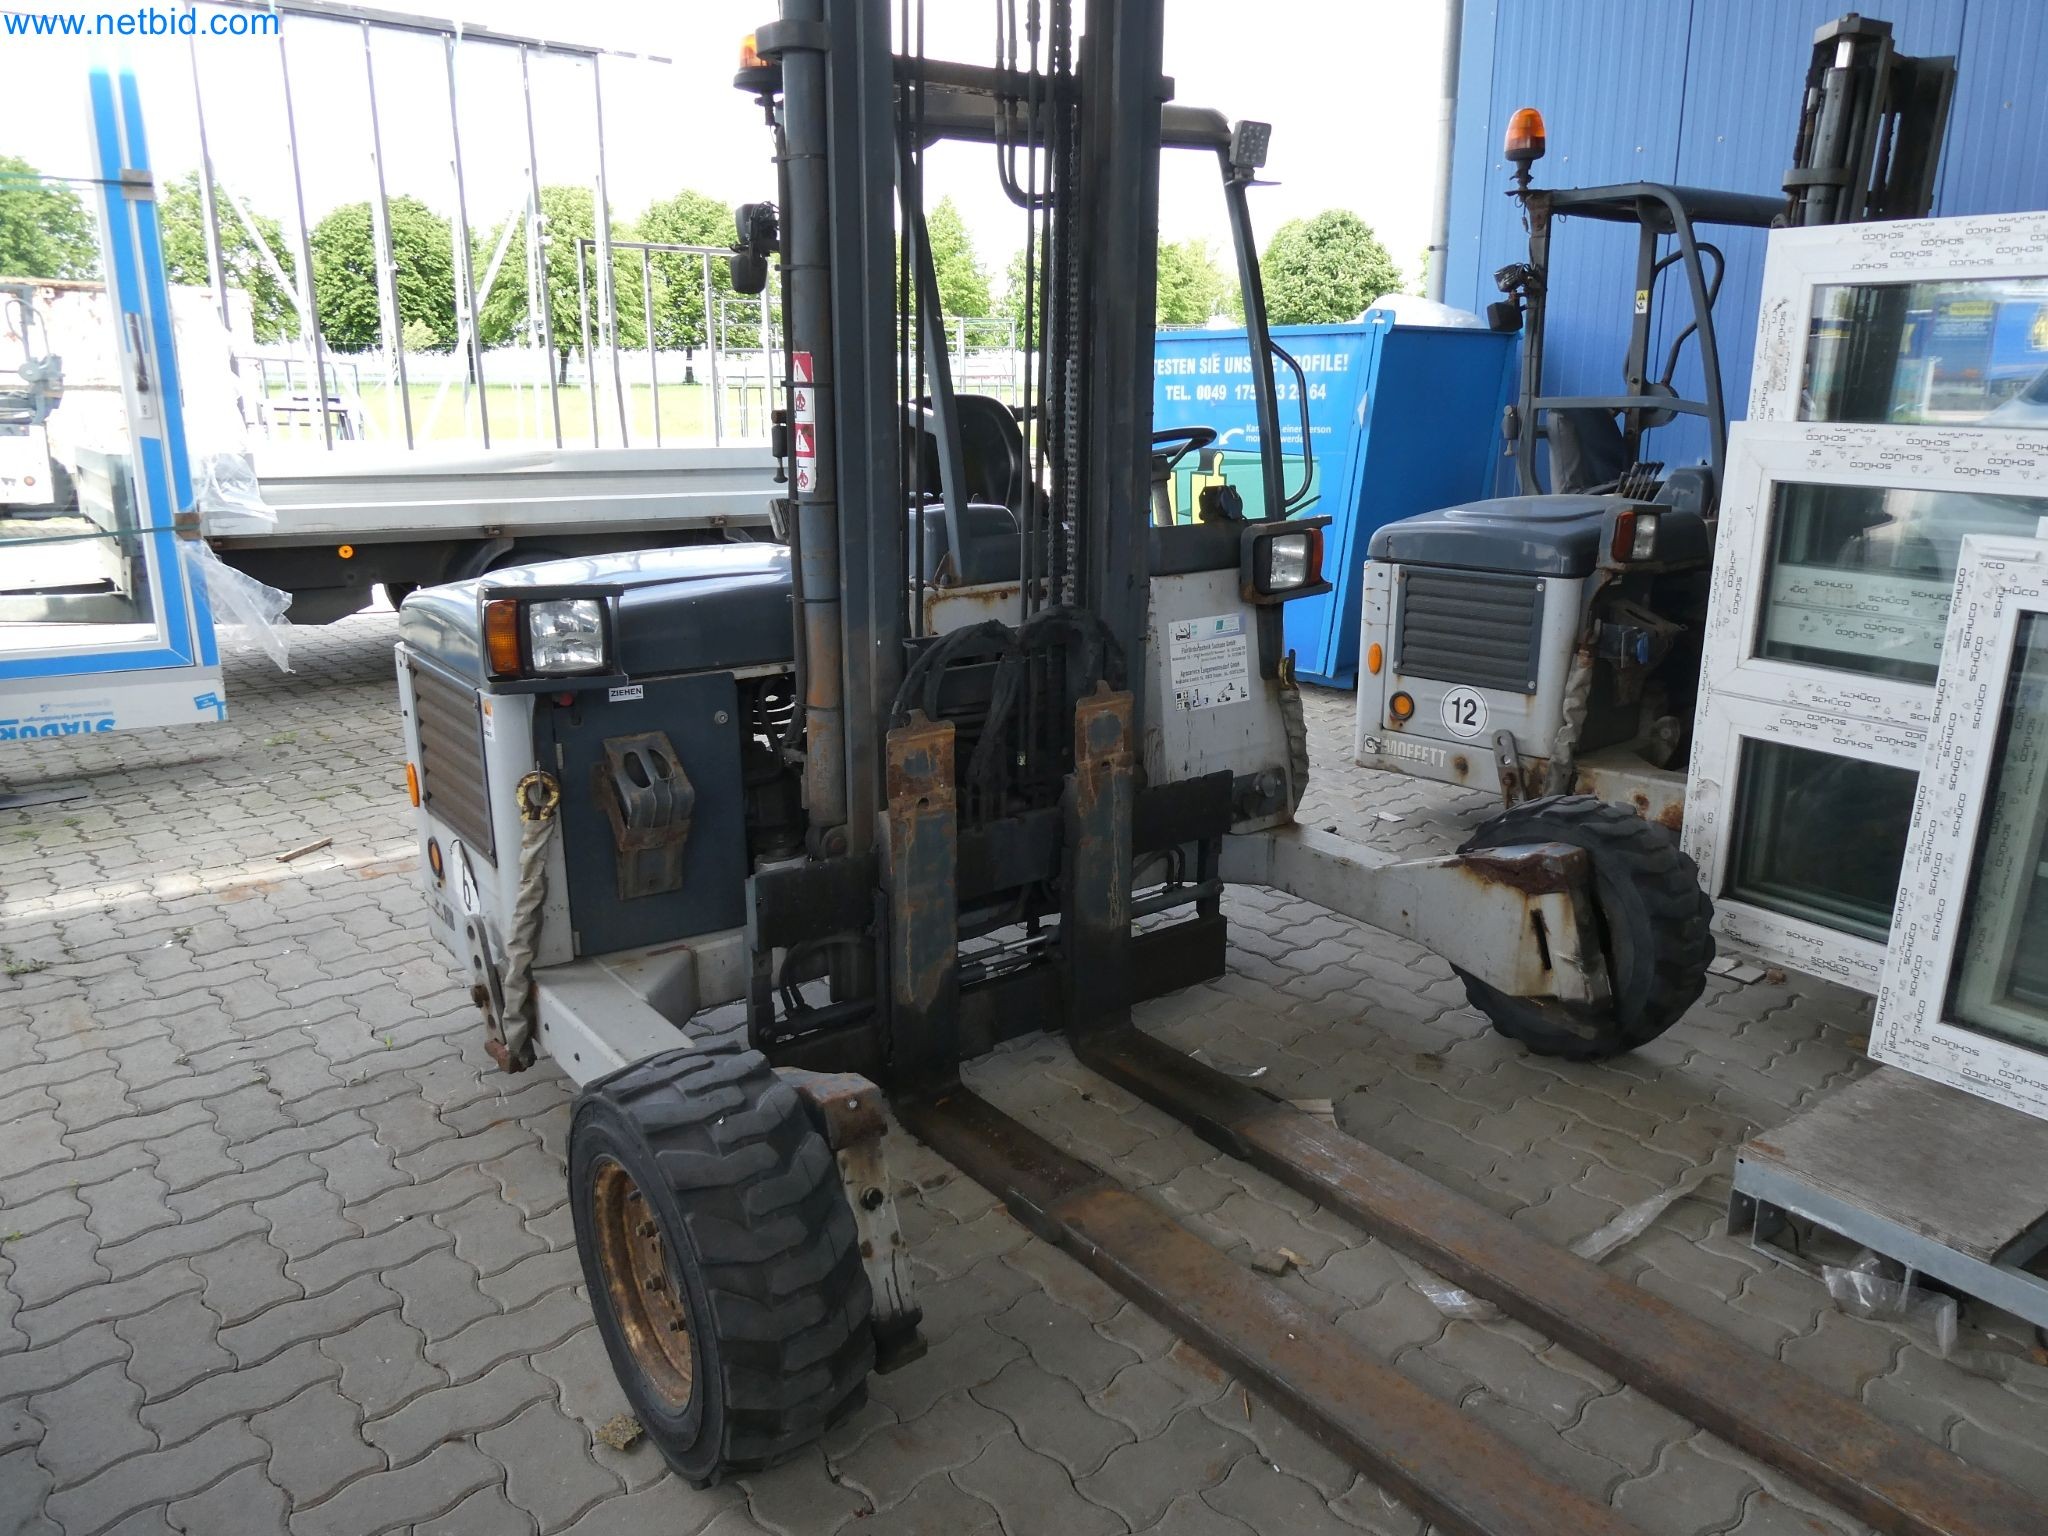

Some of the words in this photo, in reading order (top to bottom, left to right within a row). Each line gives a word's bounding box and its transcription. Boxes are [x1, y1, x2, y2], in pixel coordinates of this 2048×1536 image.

[1154, 359, 1196, 375] ESTEN
[1165, 384, 1192, 400] TEL.
[1196, 384, 1227, 400] 0049
[1309, 384, 1326, 400] 64
[610, 688, 642, 697] ZIEHEN
[1452, 696, 1477, 727] 12
[1384, 739, 1447, 767] MOFFETT
